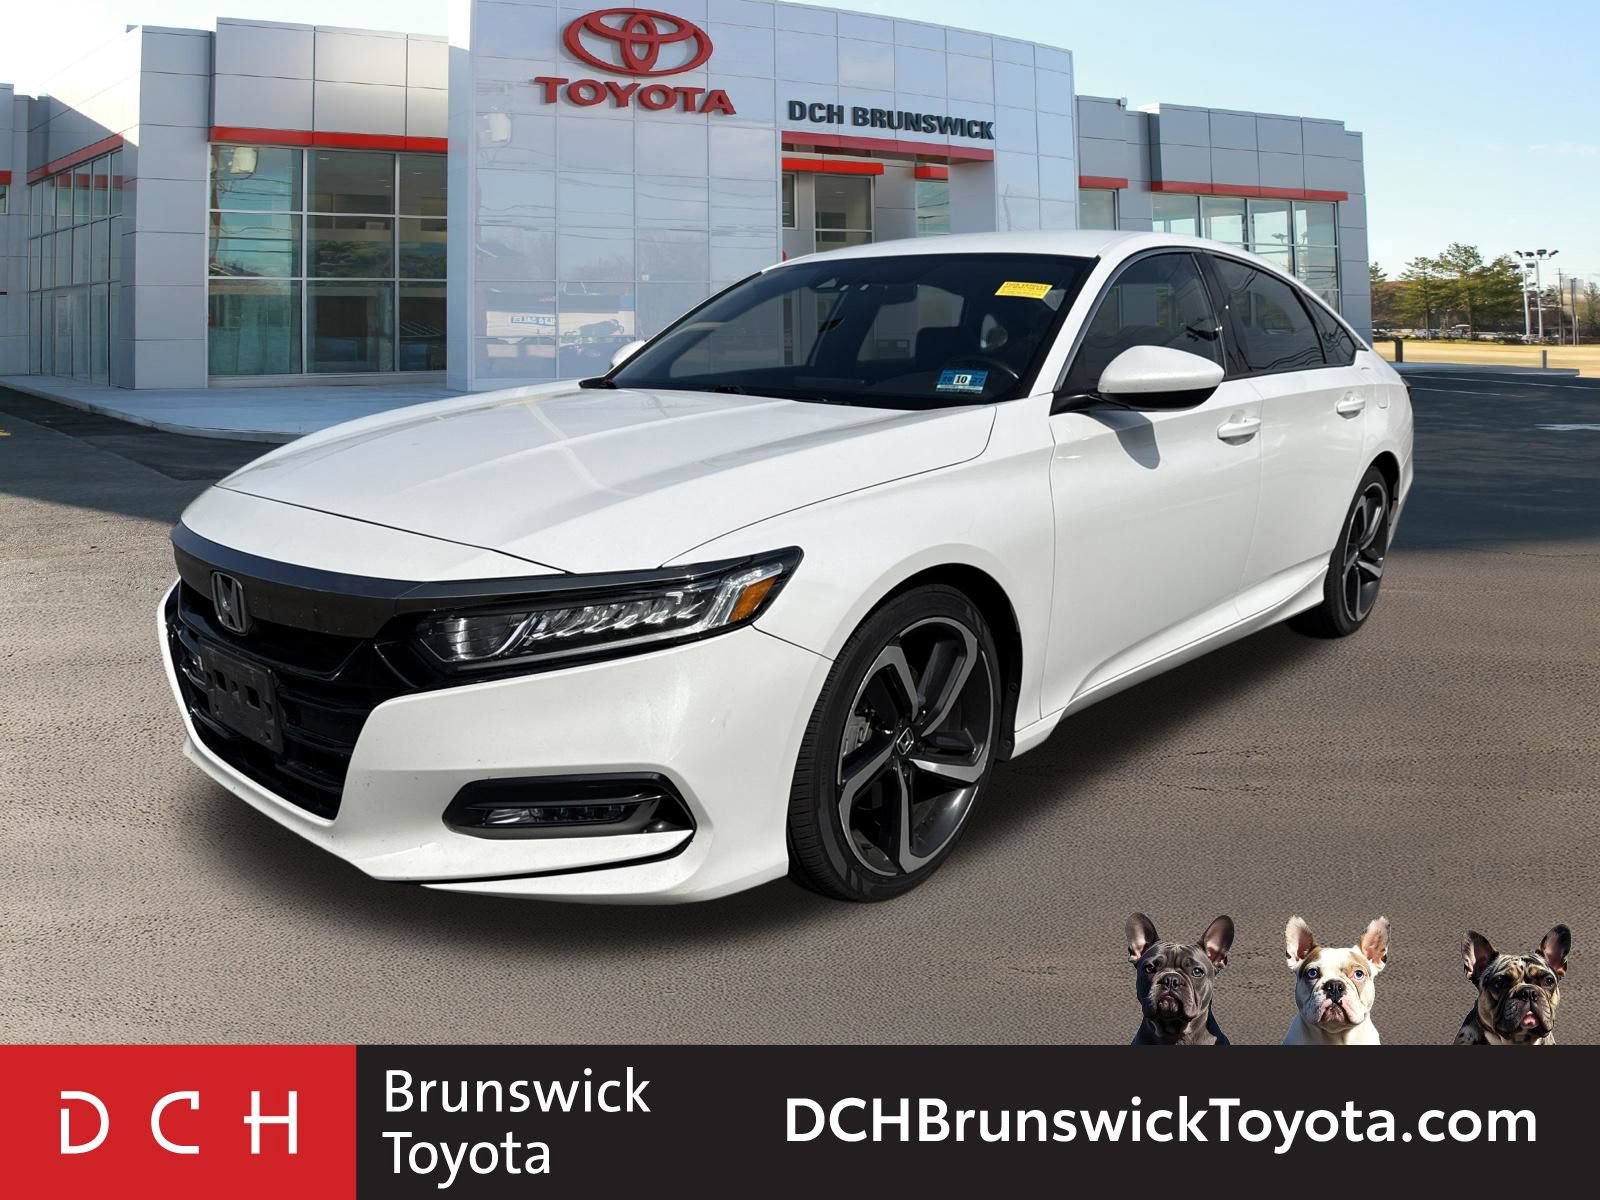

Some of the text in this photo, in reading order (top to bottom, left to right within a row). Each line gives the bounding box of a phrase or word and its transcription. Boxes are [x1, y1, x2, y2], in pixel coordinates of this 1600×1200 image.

[534, 76, 737, 115] TOYOTA
[788, 100, 995, 140] DCH BRUNSWICK
[955, 375, 968, 384] 10
